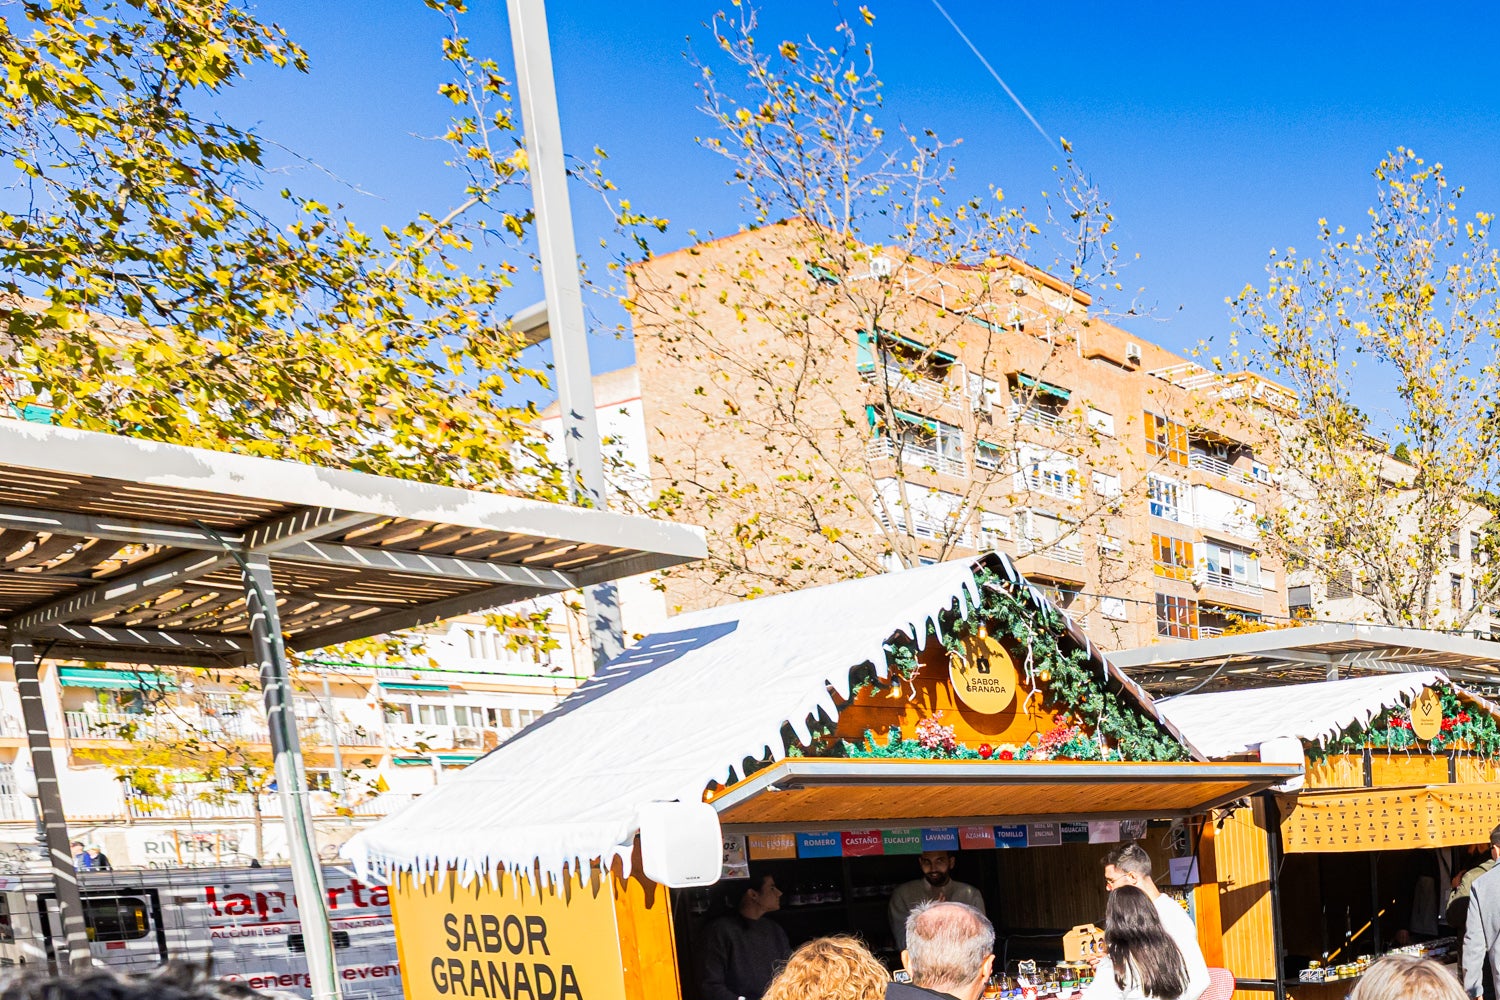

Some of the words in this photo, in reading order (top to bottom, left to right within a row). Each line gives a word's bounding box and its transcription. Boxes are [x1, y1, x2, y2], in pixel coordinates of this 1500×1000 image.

[925, 833, 955, 841] LAVANDA
[1034, 830, 1054, 838] ENCINA
[803, 838, 836, 847] ROMERO
[845, 835, 878, 845] CASTAÑO
[884, 836, 920, 844] EUCALIPTO
[205, 879, 389, 921] laprta
[443, 912, 550, 956] SABOR
